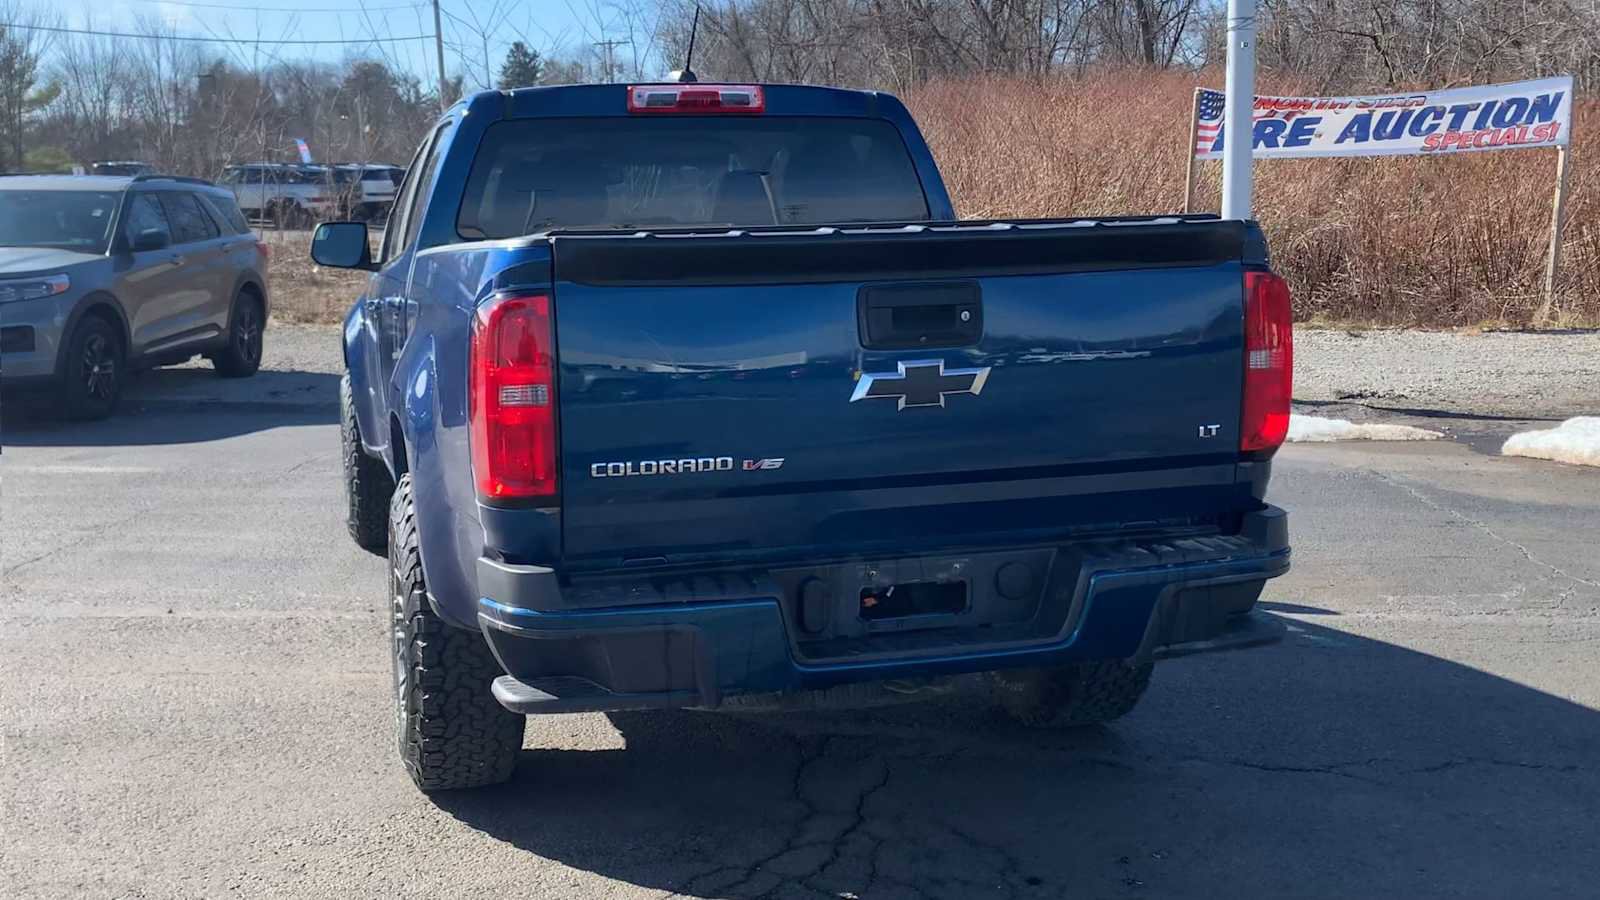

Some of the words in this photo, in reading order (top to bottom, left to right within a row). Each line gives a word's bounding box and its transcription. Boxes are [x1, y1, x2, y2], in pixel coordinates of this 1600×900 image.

[1210, 116, 1322, 152] RE
[1334, 91, 1566, 144] AUCTION
[1421, 120, 1562, 152] SPECIALS!
[1199, 424, 1221, 438] LT
[591, 457, 734, 478] COLORADO
